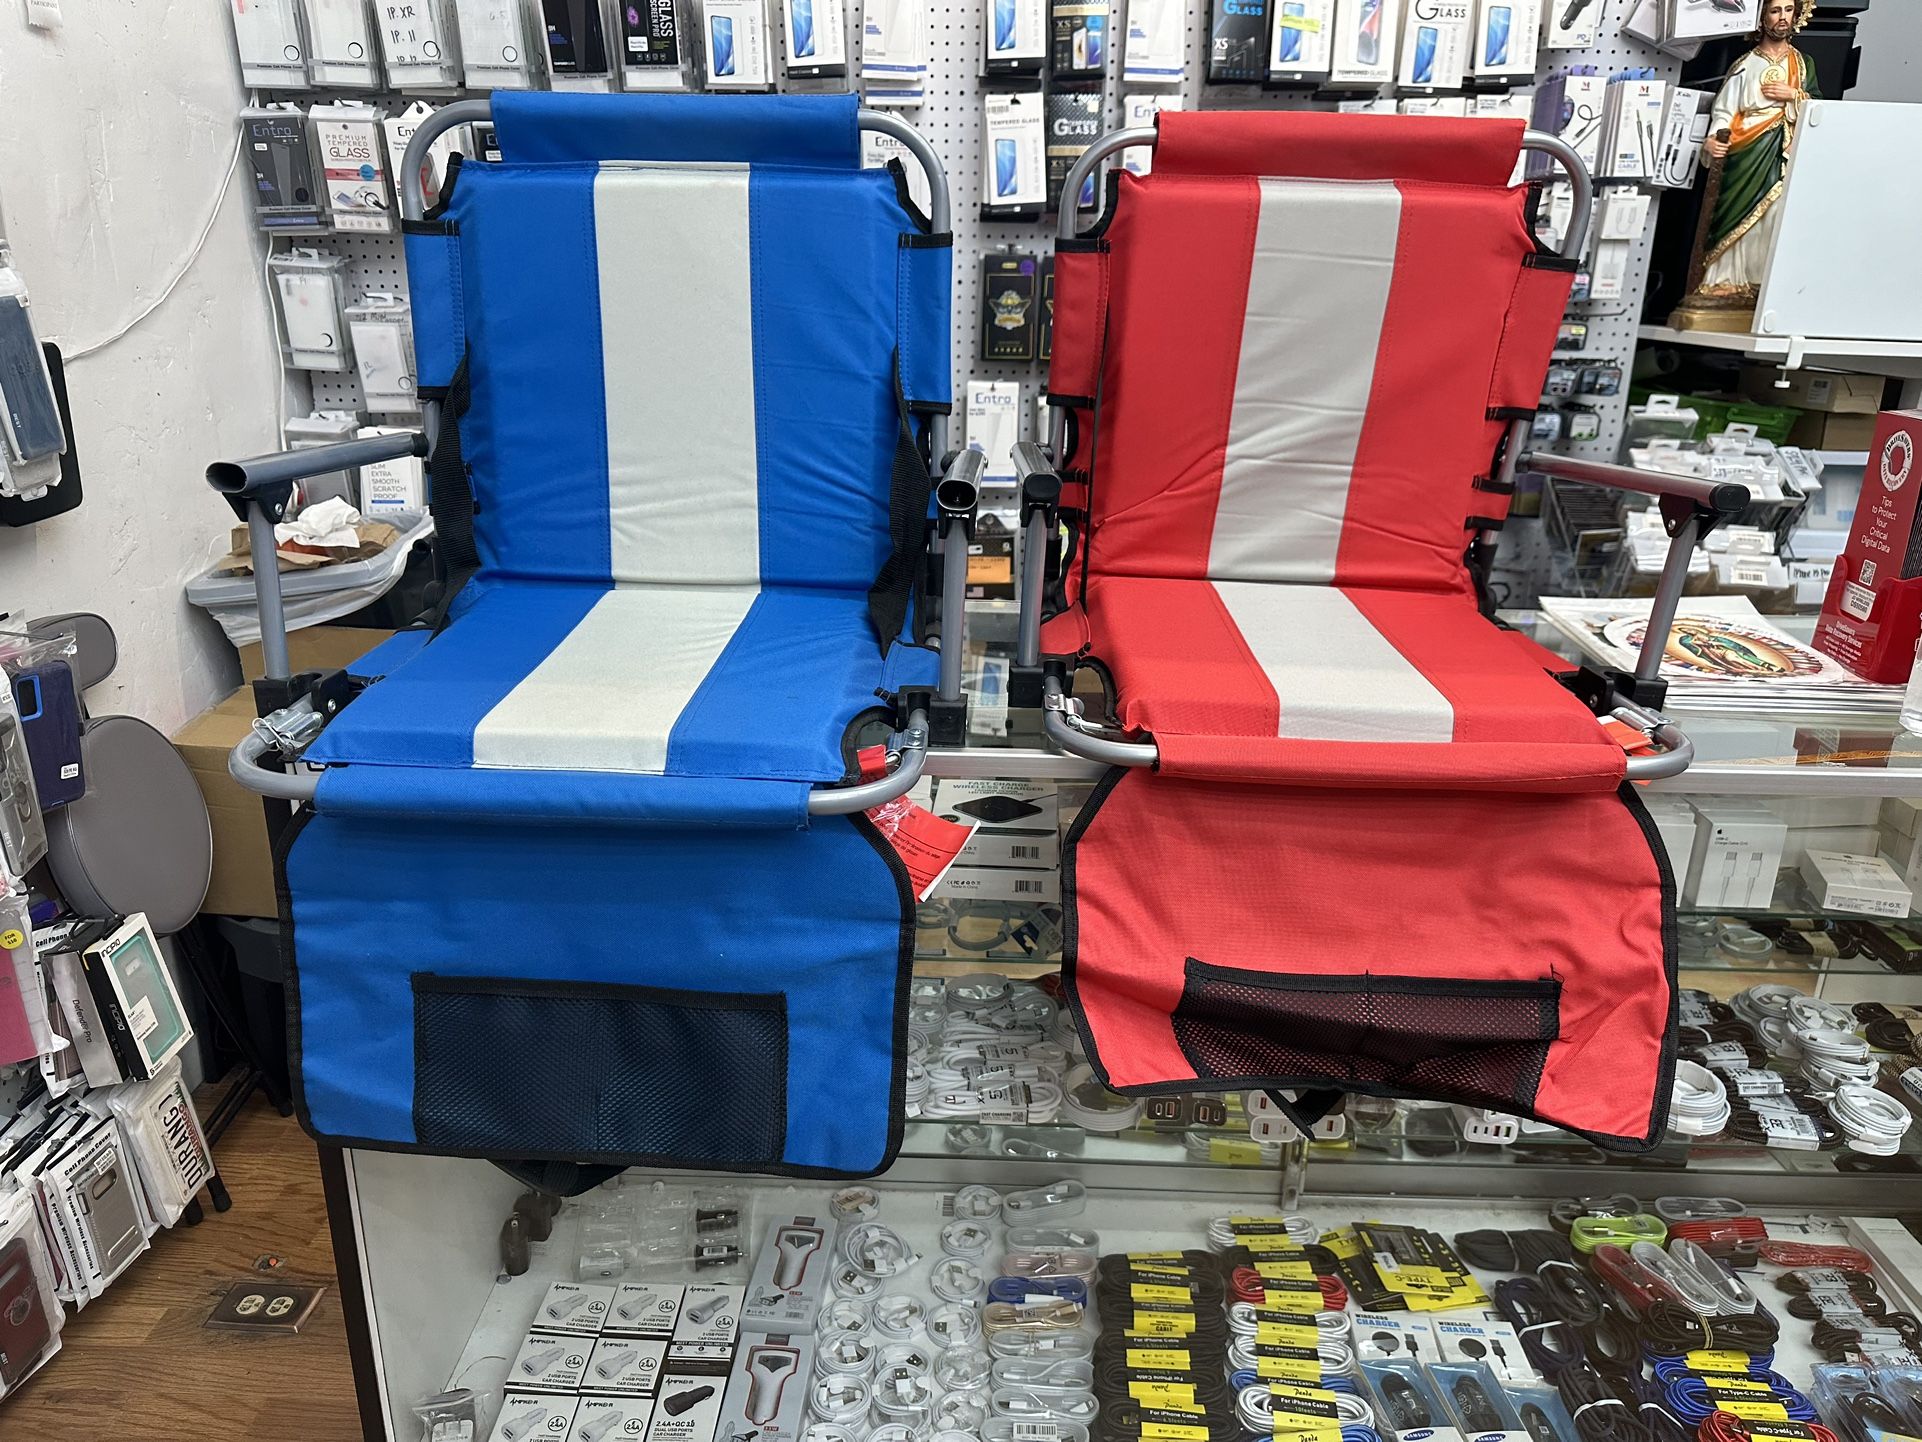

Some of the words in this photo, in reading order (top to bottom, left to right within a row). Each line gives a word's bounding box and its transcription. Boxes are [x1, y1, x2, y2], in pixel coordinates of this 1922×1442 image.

[400, 6, 415, 19] XR
[1415, 0, 1467, 20] GLASS
[658, 0, 674, 37] GLASS
[652, 24, 661, 37] PRO
[1213, 38, 1228, 50] XS
[1053, 118, 1098, 136] GLASS
[329, 147, 371, 159] GLASS
[975, 392, 1012, 404] Entro
[12, 413, 22, 428] BEST
[1881, 496, 1893, 507] Tips
[1878, 506, 1897, 520] Protect
[1876, 517, 1888, 528] Your
[1869, 527, 1889, 540] Critical
[1861, 535, 1879, 548] Digital
[1877, 541, 1891, 553] Data
[4, 832, 13, 848] BEST
[5, 933, 15, 941] FOR
[35, 939, 47, 948] Cell
[48, 933, 67, 944] Phone
[72, 999, 87, 1027] Defender
[83, 1028, 92, 1043] Pro
[64, 1162, 78, 1177] Cell
[76, 1147, 96, 1167] Phone
[94, 1132, 112, 1149] Cover
[67, 1195, 78, 1218] Premium
[75, 1218, 86, 1240] Wireless
[82, 1239, 95, 1270] Accessories
[51, 1202, 64, 1227] Premium
[61, 1227, 73, 1251] Wireless
[69, 1249, 83, 1281] Accessories
[1396, 1275, 1432, 1283] TYPE-C
[1356, 1319, 1400, 1327] CHARGER
[1440, 1326, 1484, 1334] CHARGER
[1293, 1388, 1313, 1396] Panda
[1291, 1399, 1312, 1407] iPhone
[1312, 1401, 1329, 1409] Cable
[1404, 1431, 1434, 1440] SAMSUNG
[1477, 1434, 1505, 1442] SAMSUNG
[1773, 1428, 1793, 1436] Type-C
